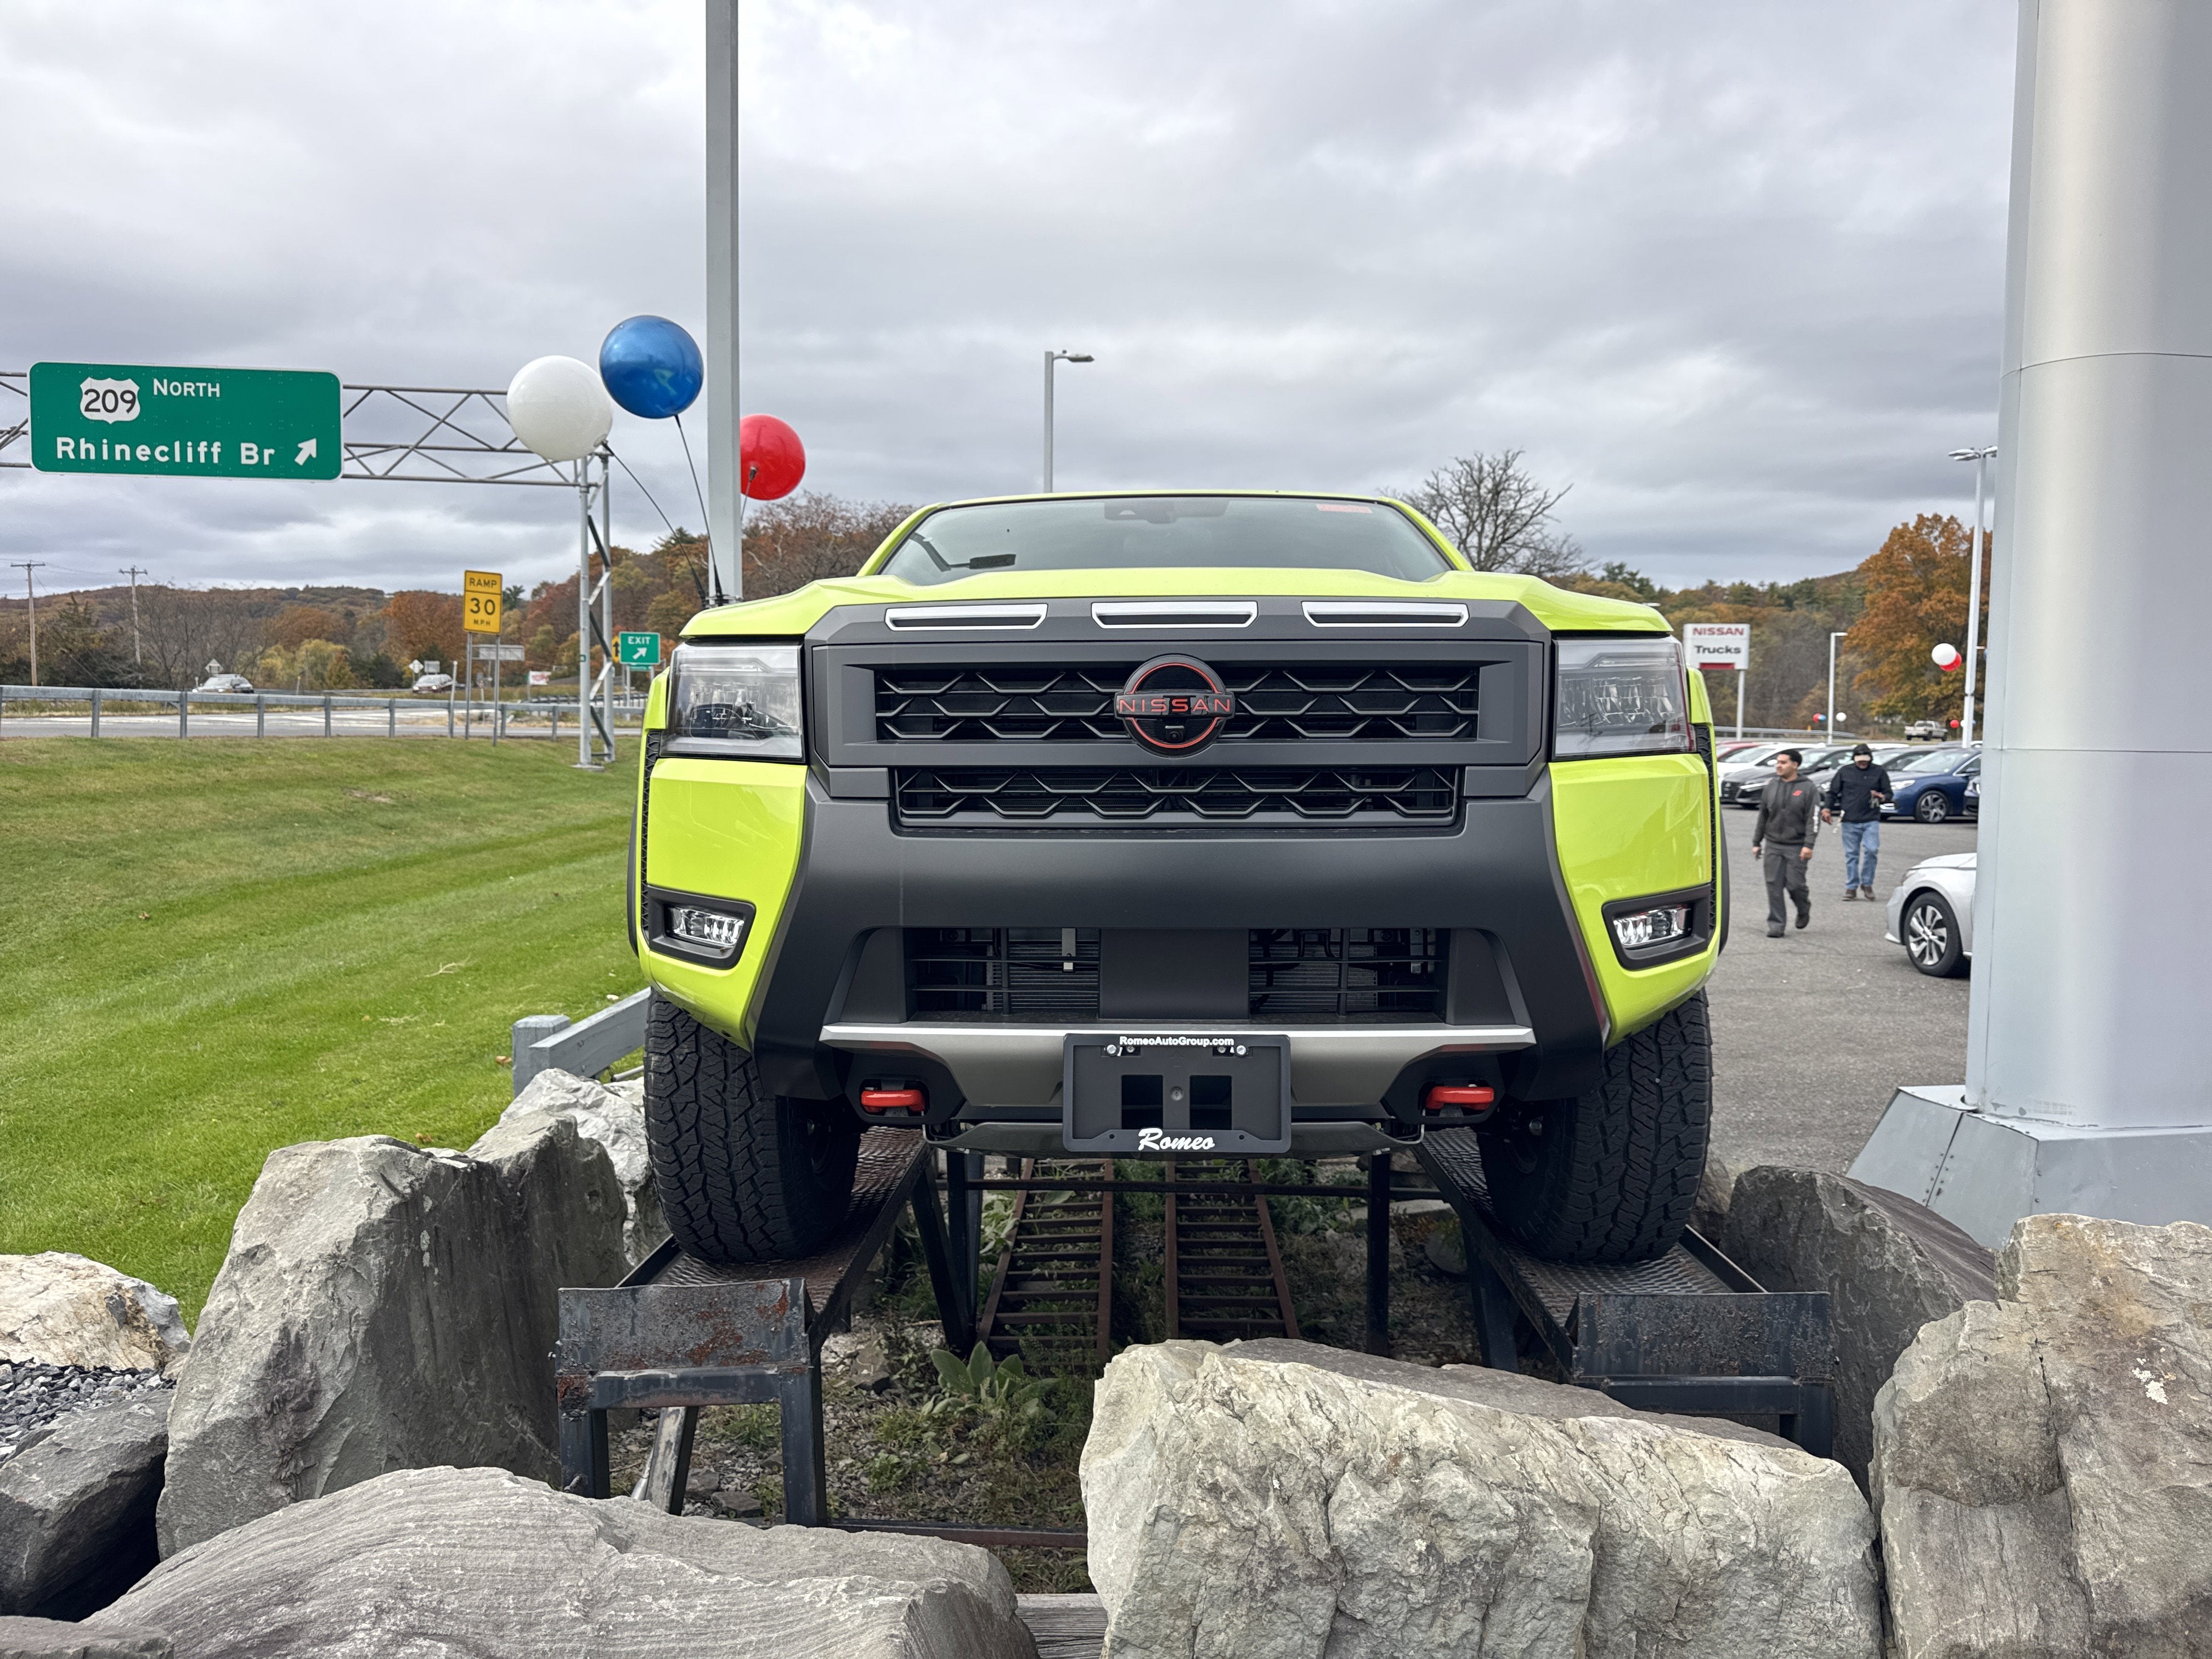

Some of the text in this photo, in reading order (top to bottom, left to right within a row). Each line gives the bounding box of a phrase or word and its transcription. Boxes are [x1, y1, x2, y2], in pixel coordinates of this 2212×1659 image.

[154, 379, 221, 398] NORTH
[83, 388, 137, 414] 209
[57, 437, 275, 466] Rhinecliff Br
[469, 577, 497, 589] RAMP
[470, 597, 495, 615] 30
[1693, 627, 1744, 636] NISSAN
[628, 636, 651, 645] EXIT
[1695, 645, 1741, 654] Trucks
[1118, 698, 1231, 713] NISSAN
[1119, 1036, 1234, 1047] RomeoAutoGroup.com
[1138, 1127, 1215, 1151] Romeo
